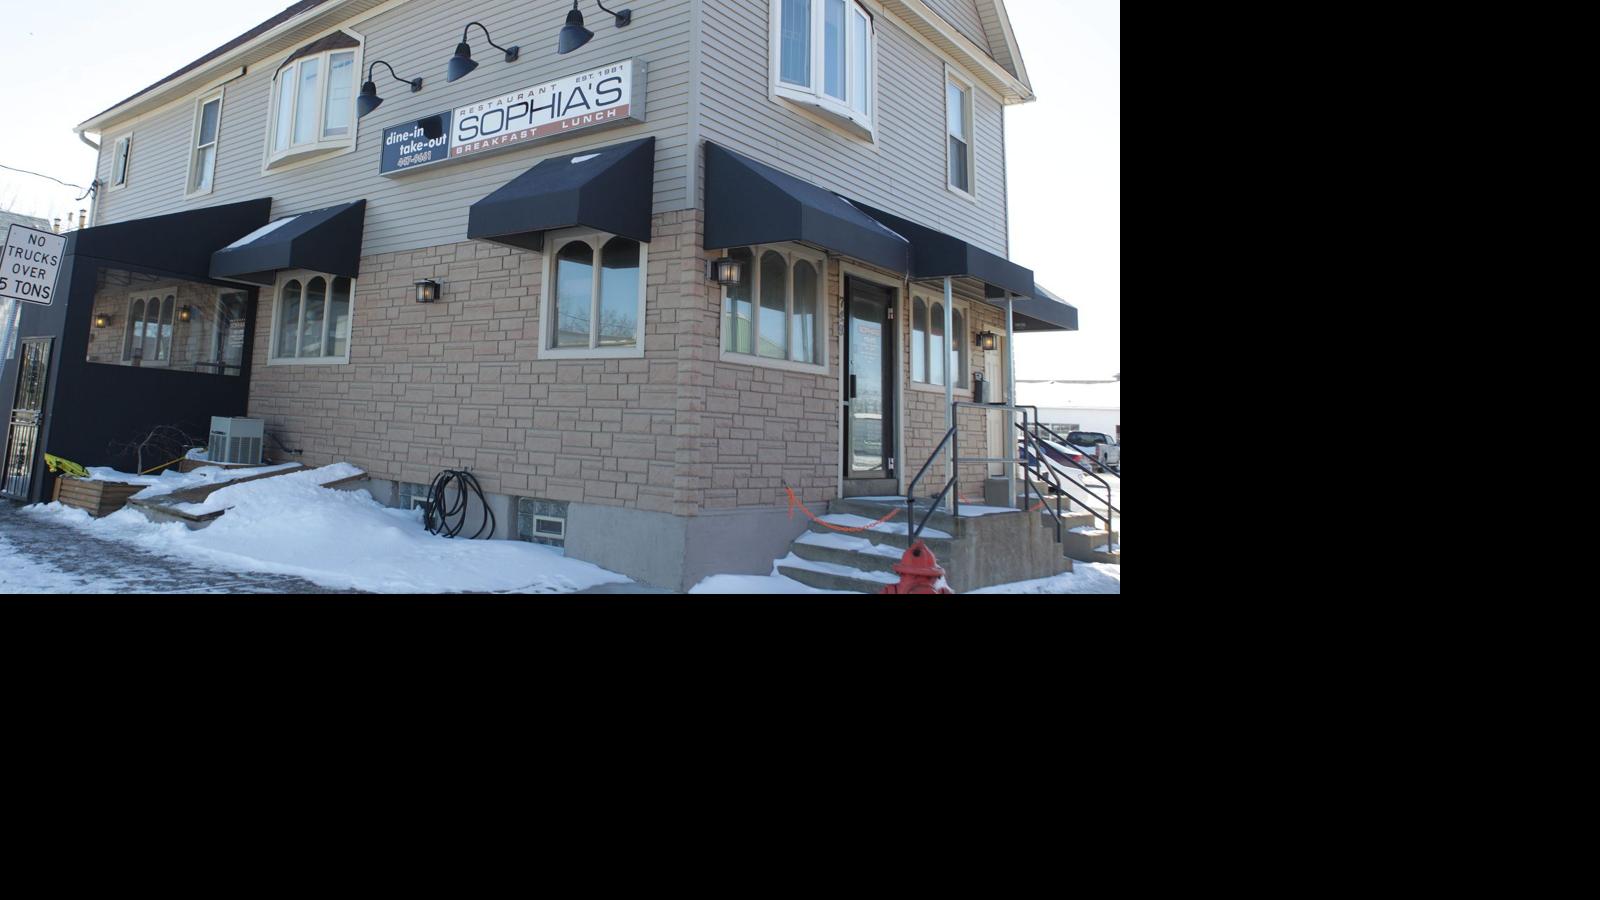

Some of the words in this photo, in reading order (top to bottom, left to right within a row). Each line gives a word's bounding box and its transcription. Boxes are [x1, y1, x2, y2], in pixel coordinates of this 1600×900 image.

[460, 83, 557, 116] RESTAURANT
[575, 74, 595, 83] EST.
[598, 65, 624, 77] 1981
[458, 76, 623, 142] SOPHIA'S
[386, 126, 424, 145] dine-in
[456, 128, 537, 155] BREAKFAST
[562, 108, 616, 129] LUNCH
[400, 133, 447, 155] take-out
[28, 233, 46, 247] NO
[8, 245, 58, 266] TRUCKS
[12, 263, 46, 280] OVER
[0, 277, 8, 290] 5
[15, 279, 51, 299] TONS
